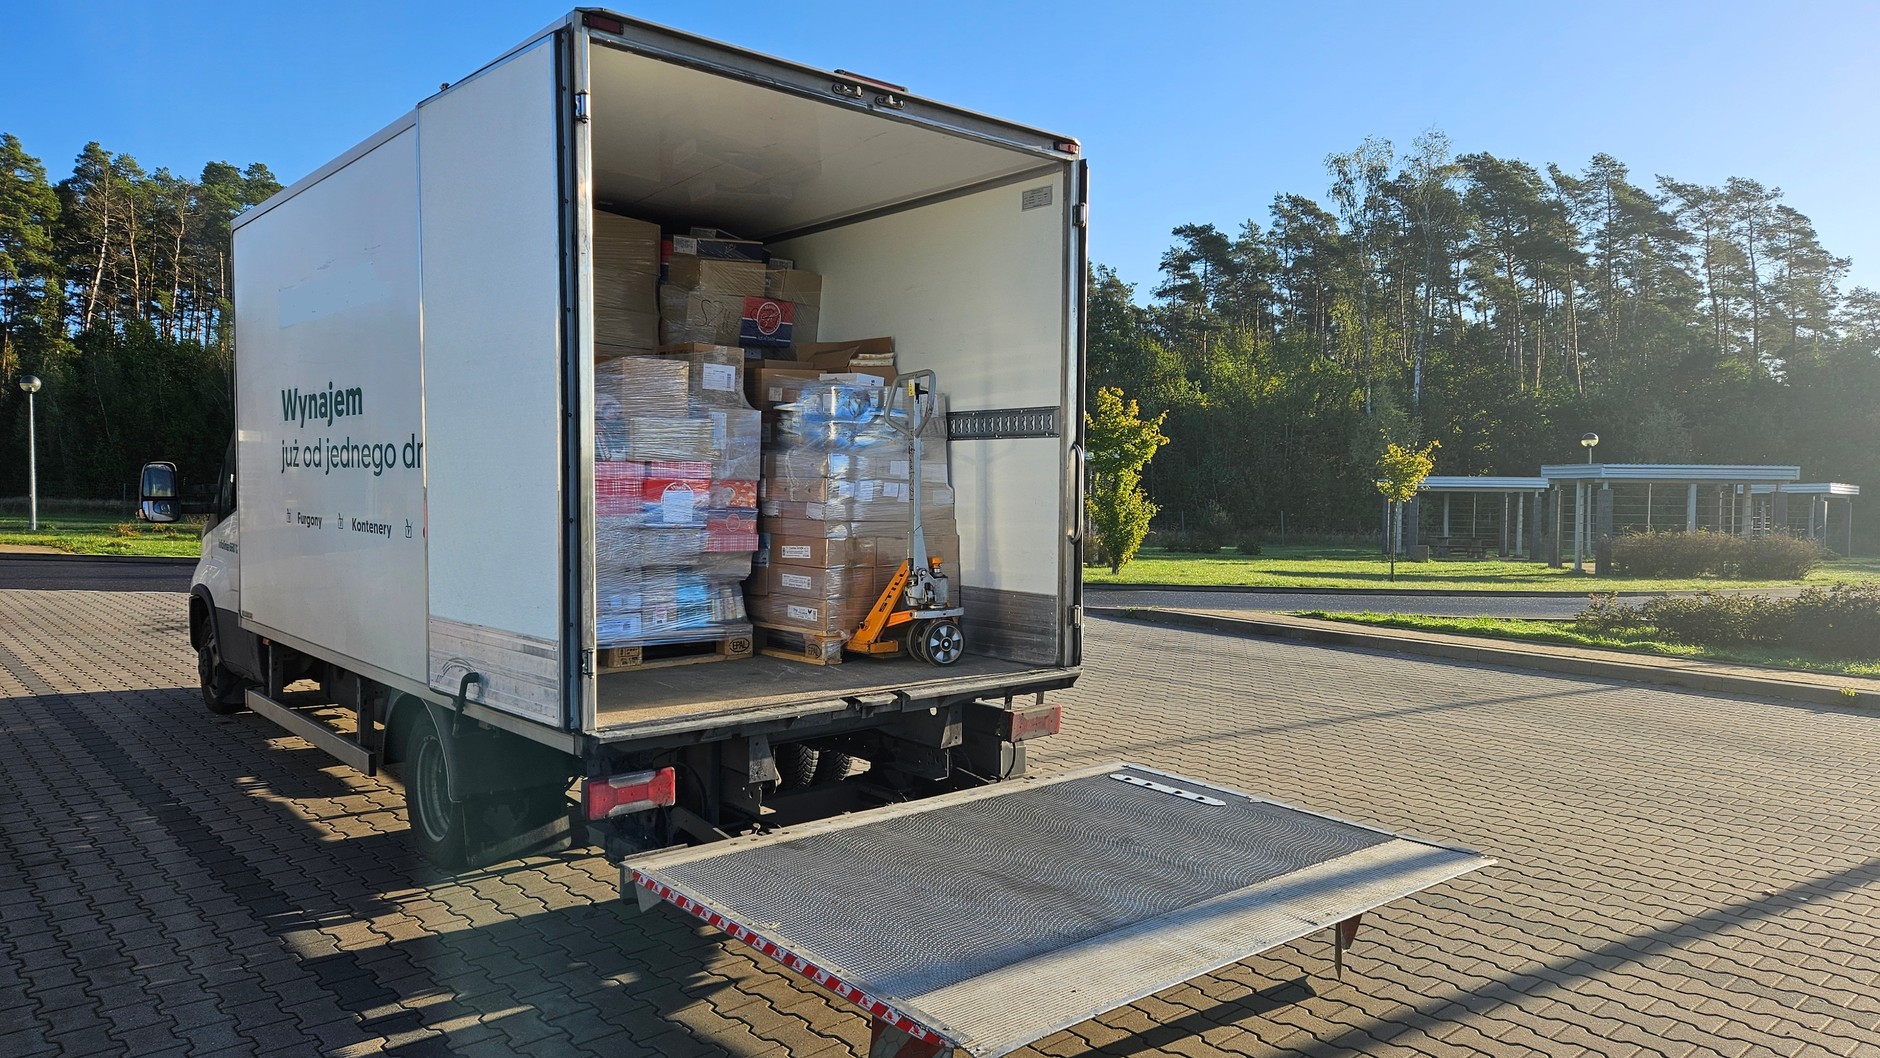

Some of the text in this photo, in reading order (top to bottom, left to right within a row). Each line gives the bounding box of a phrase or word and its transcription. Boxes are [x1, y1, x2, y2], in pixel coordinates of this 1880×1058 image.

[281, 381, 363, 428] Wynajem
[281, 439, 300, 474] już
[303, 438, 322, 468] od
[325, 436, 397, 477] jednego
[297, 512, 323, 529] Furgony
[351, 518, 392, 538] Kontenery
[878, 569, 908, 613] STILL
[732, 640, 747, 650] EPAL
